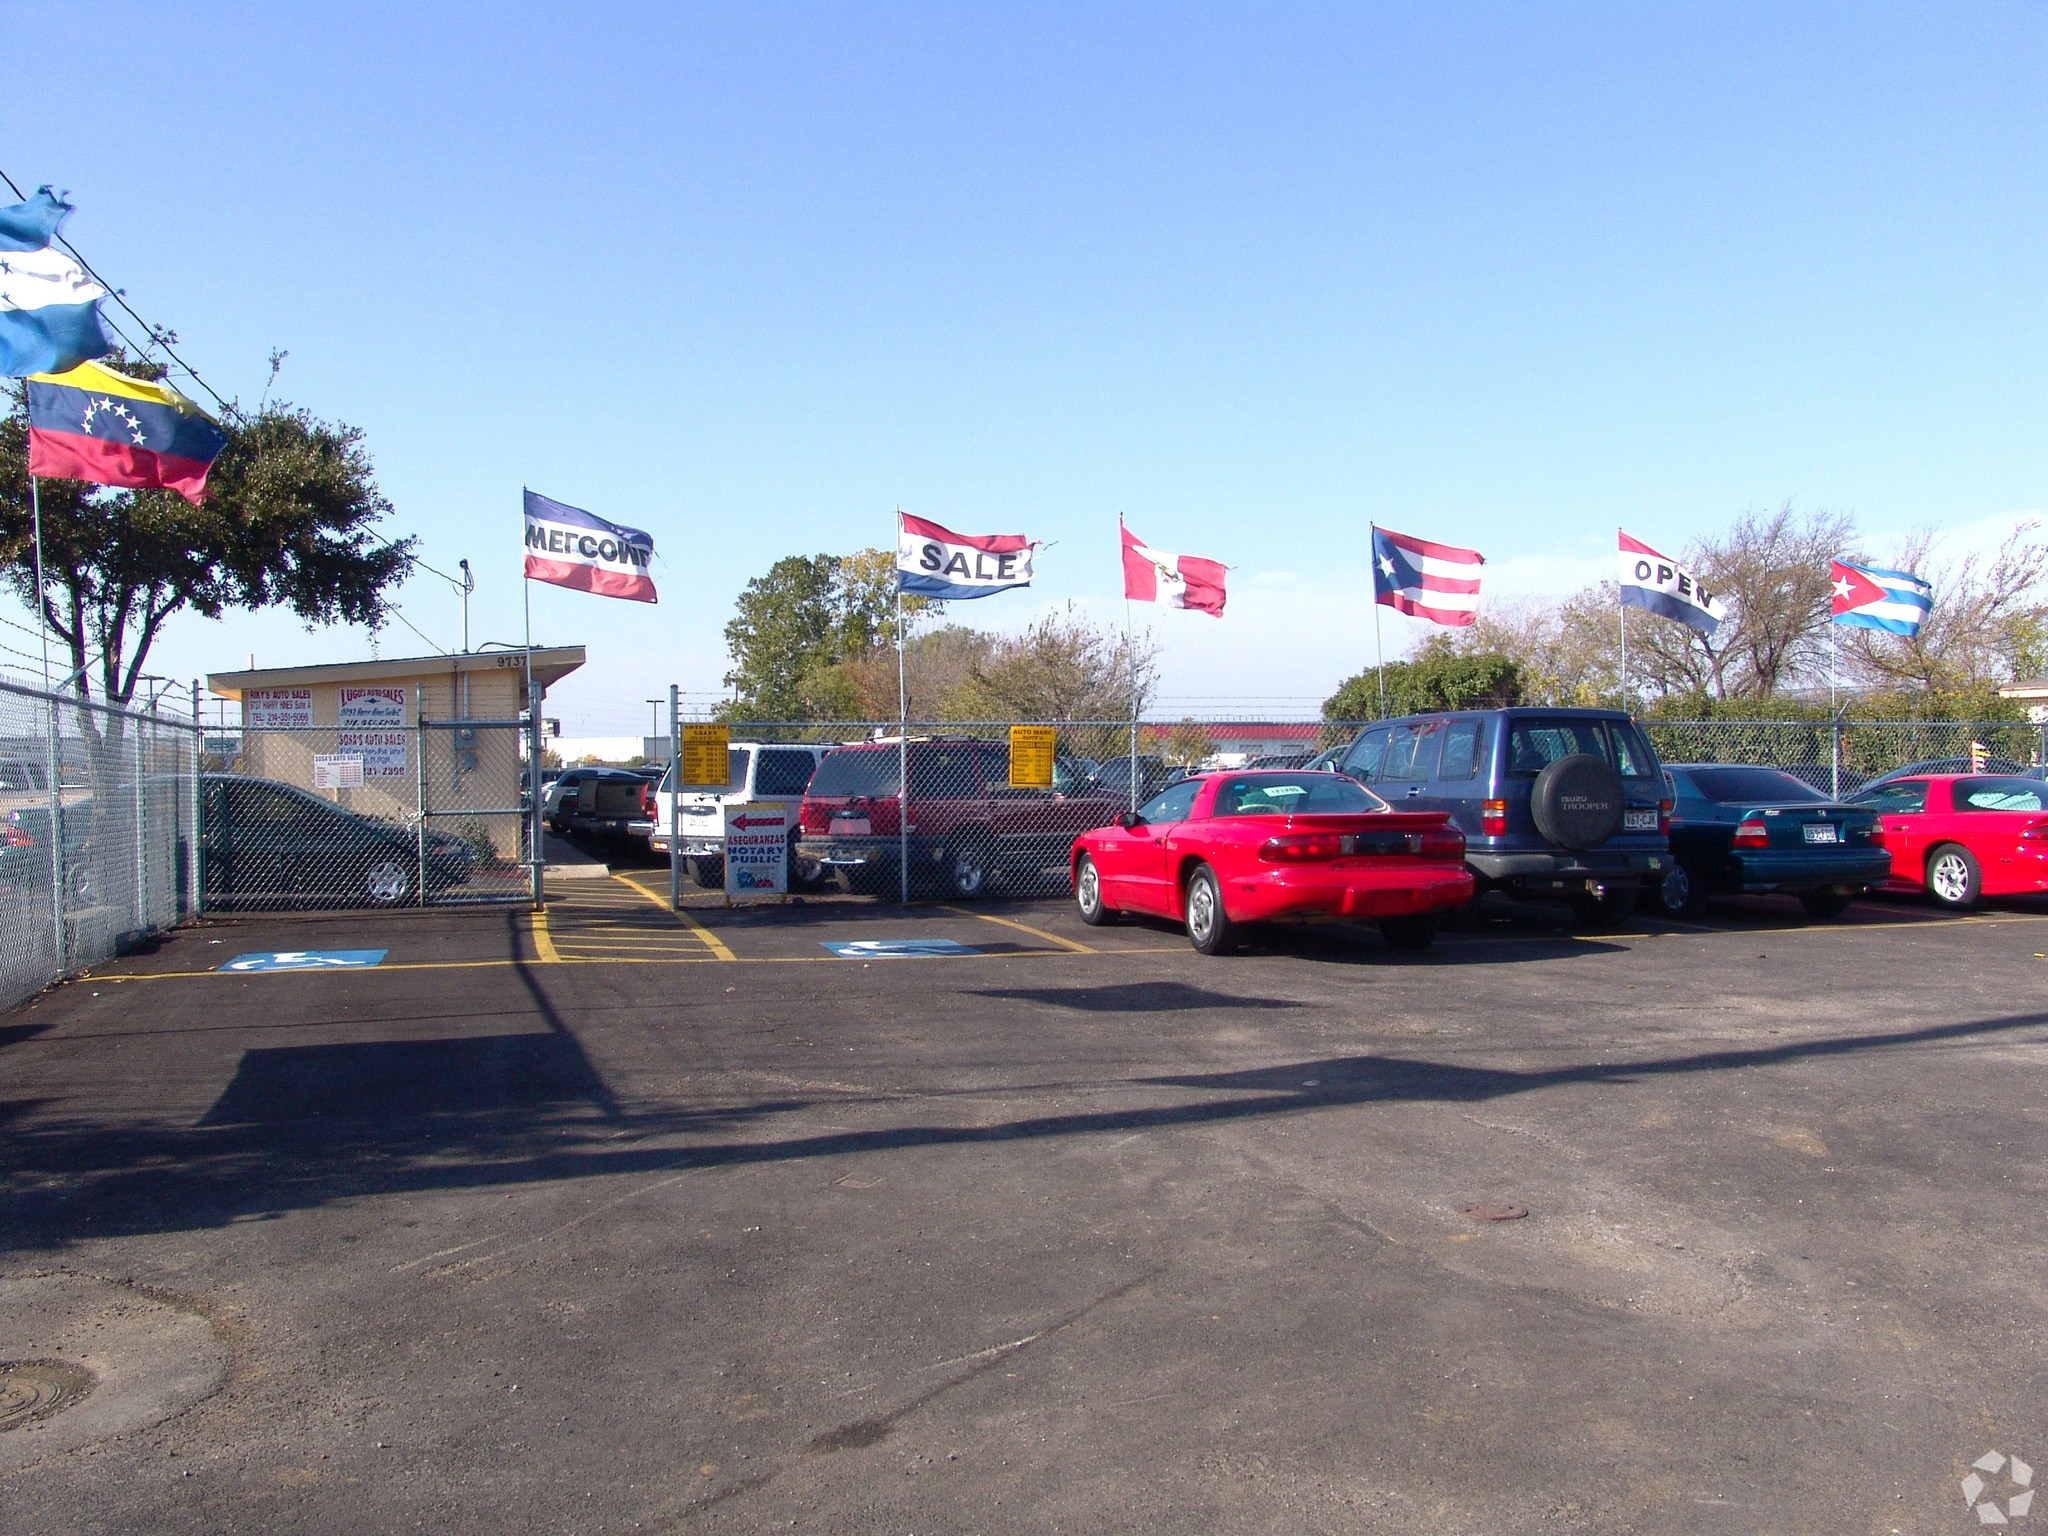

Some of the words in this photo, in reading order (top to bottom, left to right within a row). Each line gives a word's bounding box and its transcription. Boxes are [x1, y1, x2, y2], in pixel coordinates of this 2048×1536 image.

[919, 544, 1017, 580] SALE
[1634, 560, 1713, 609] OPEN
[497, 655, 528, 667] 9737
[273, 690, 290, 699] AUTO
[292, 690, 311, 699] SALES
[367, 689, 382, 697] AUTO
[383, 689, 404, 705] SALES
[365, 733, 383, 746] AUTO
[384, 733, 406, 746] SALES
[727, 835, 785, 846] ASEGURANZAS
[727, 846, 785, 855] NOTARY
[730, 856, 781, 864] PUBLIC
